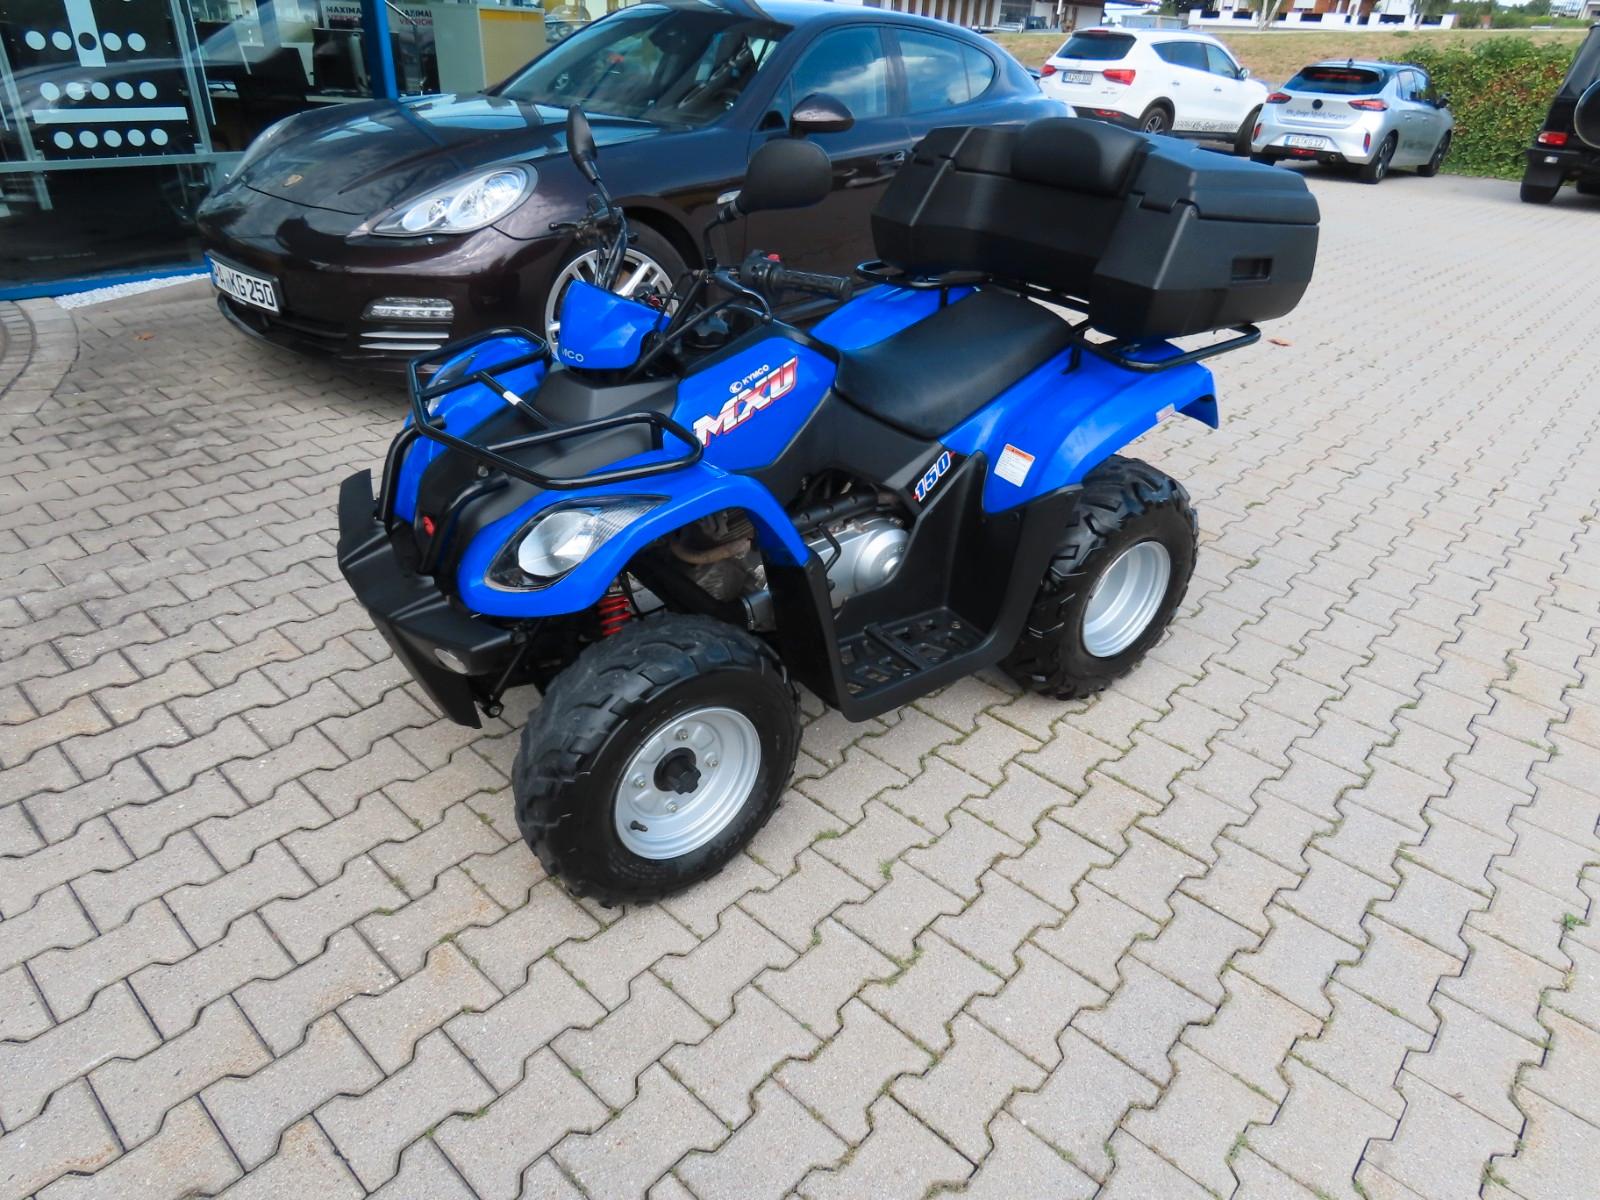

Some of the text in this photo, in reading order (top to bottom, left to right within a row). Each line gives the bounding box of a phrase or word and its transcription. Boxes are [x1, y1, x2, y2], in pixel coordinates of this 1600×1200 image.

[246, 278, 275, 307] 250
[741, 364, 769, 386] KYMCO
[693, 357, 797, 447] MXU
[914, 450, 951, 502] 150
